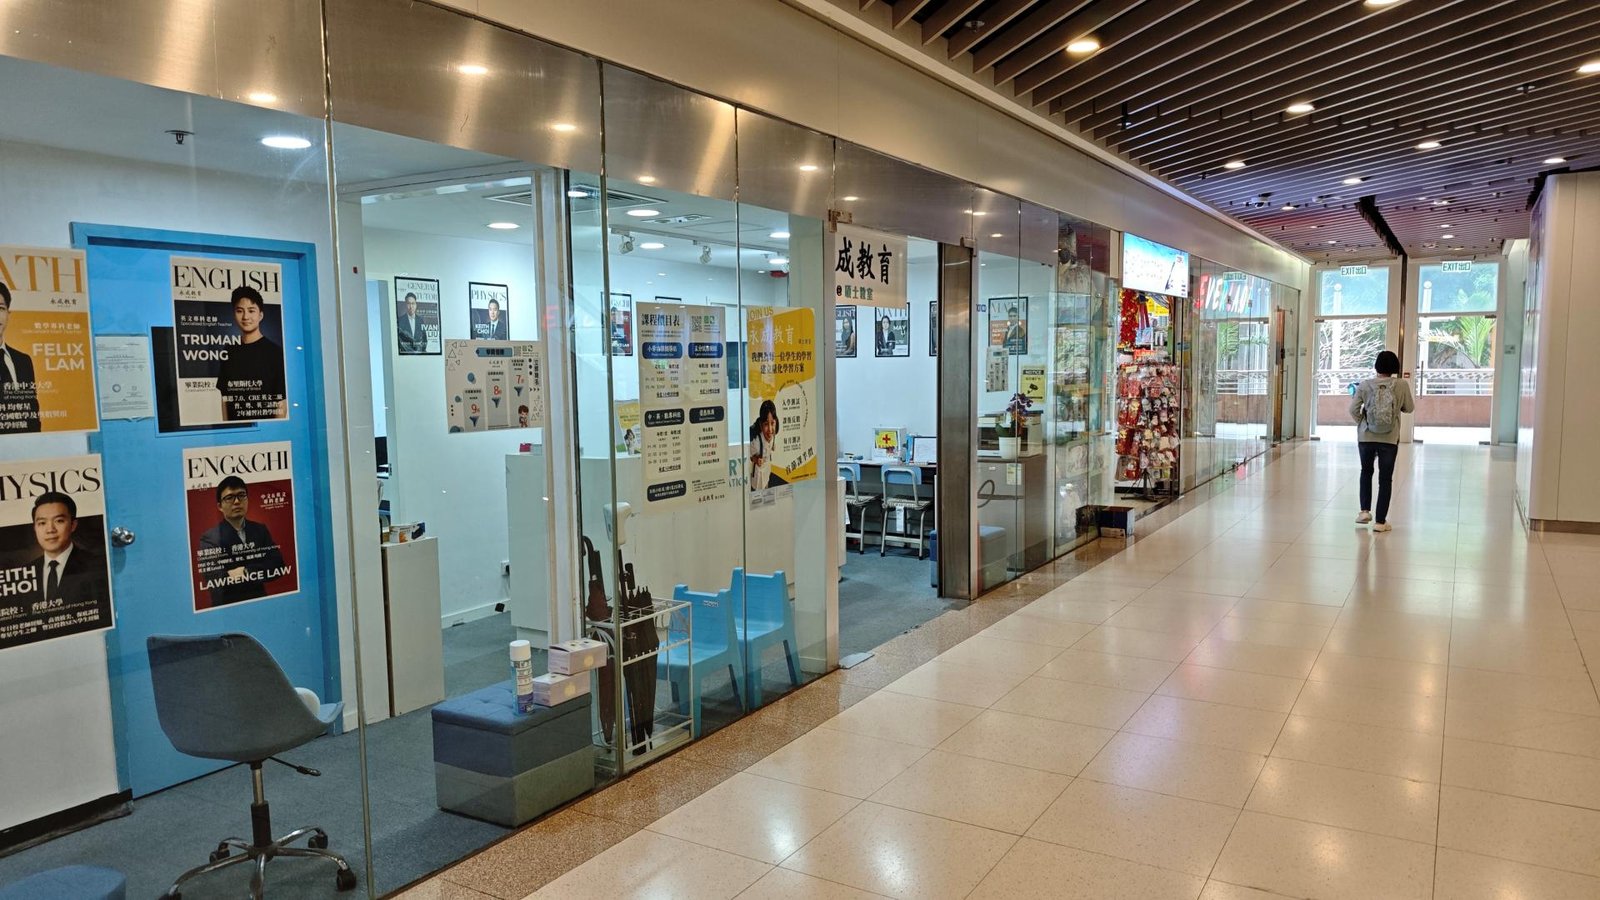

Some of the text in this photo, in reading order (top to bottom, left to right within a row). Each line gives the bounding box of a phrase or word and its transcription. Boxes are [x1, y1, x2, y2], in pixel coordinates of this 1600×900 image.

[835, 236, 892, 285] 成教育
[173, 264, 280, 292] ENGLISH
[641, 313, 680, 327] 課程價目表
[181, 334, 242, 345] TRUMAN
[32, 342, 84, 357] FELIX
[182, 350, 229, 361] WONG
[45, 358, 85, 371] LAM
[4, 381, 53, 391] 香港中文大學
[188, 450, 288, 479] ENG&CHI
[200, 570, 264, 590] LAWRENCE
[266, 565, 292, 578] LAW
[0, 578, 38, 597] HOI
[32, 598, 63, 611] 香港大學
